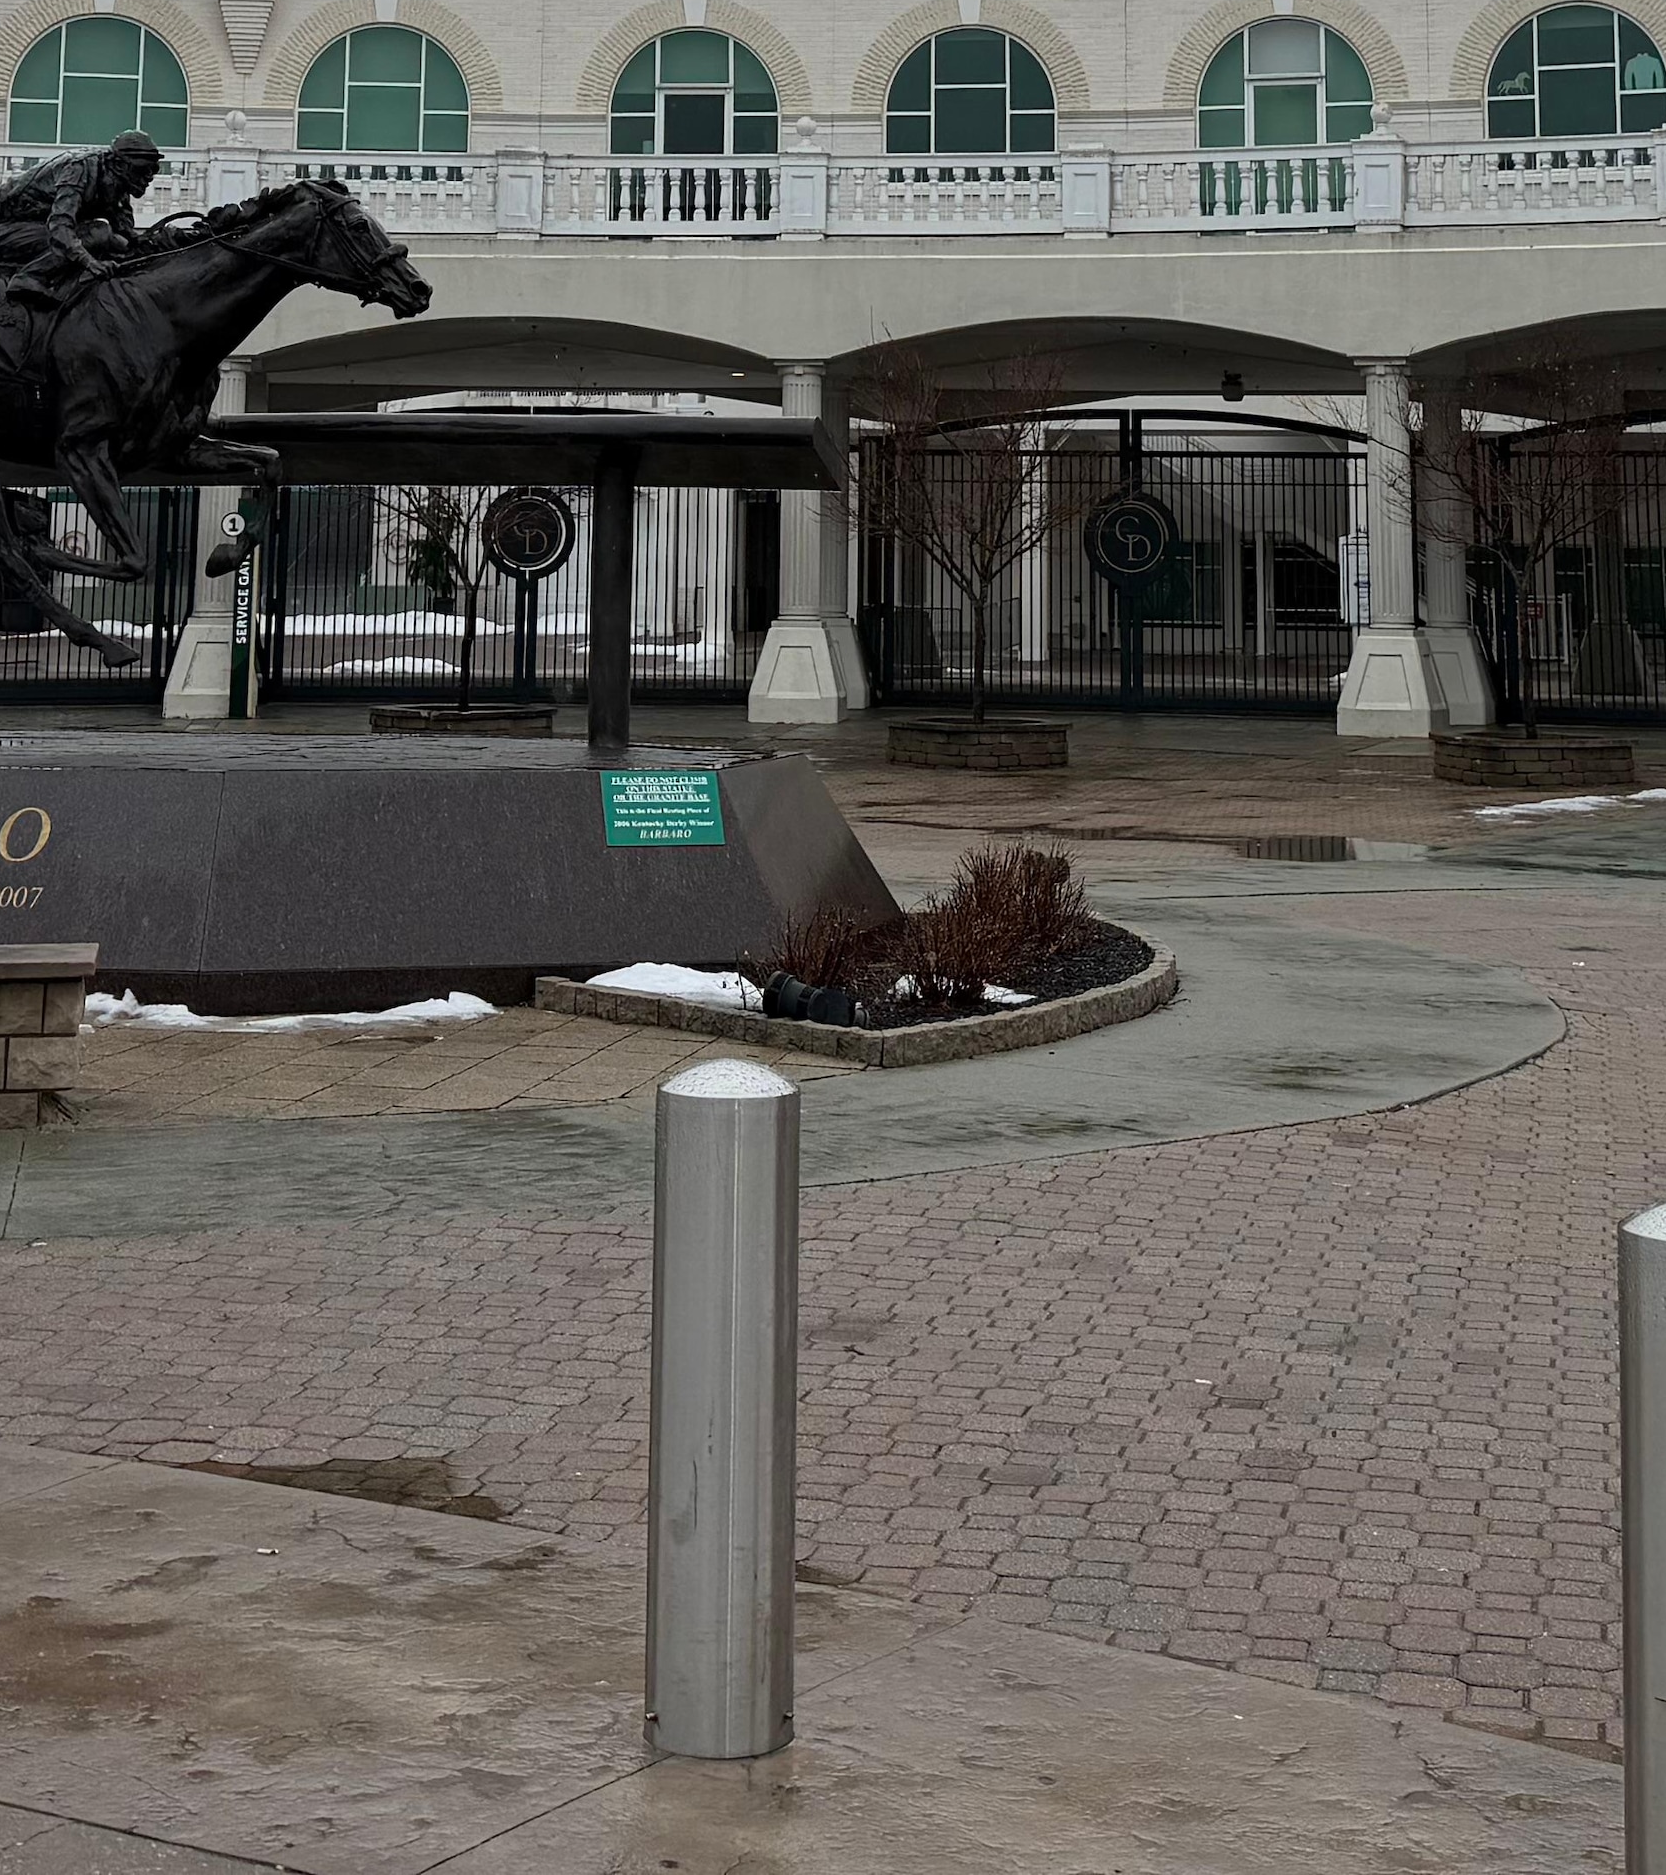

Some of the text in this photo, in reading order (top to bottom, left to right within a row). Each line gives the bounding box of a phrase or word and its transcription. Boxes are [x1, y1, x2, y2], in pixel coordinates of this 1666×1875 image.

[228, 517, 239, 532] 1
[236, 553, 251, 644] SERVICE GAT
[640, 830, 691, 839] BARBARO
